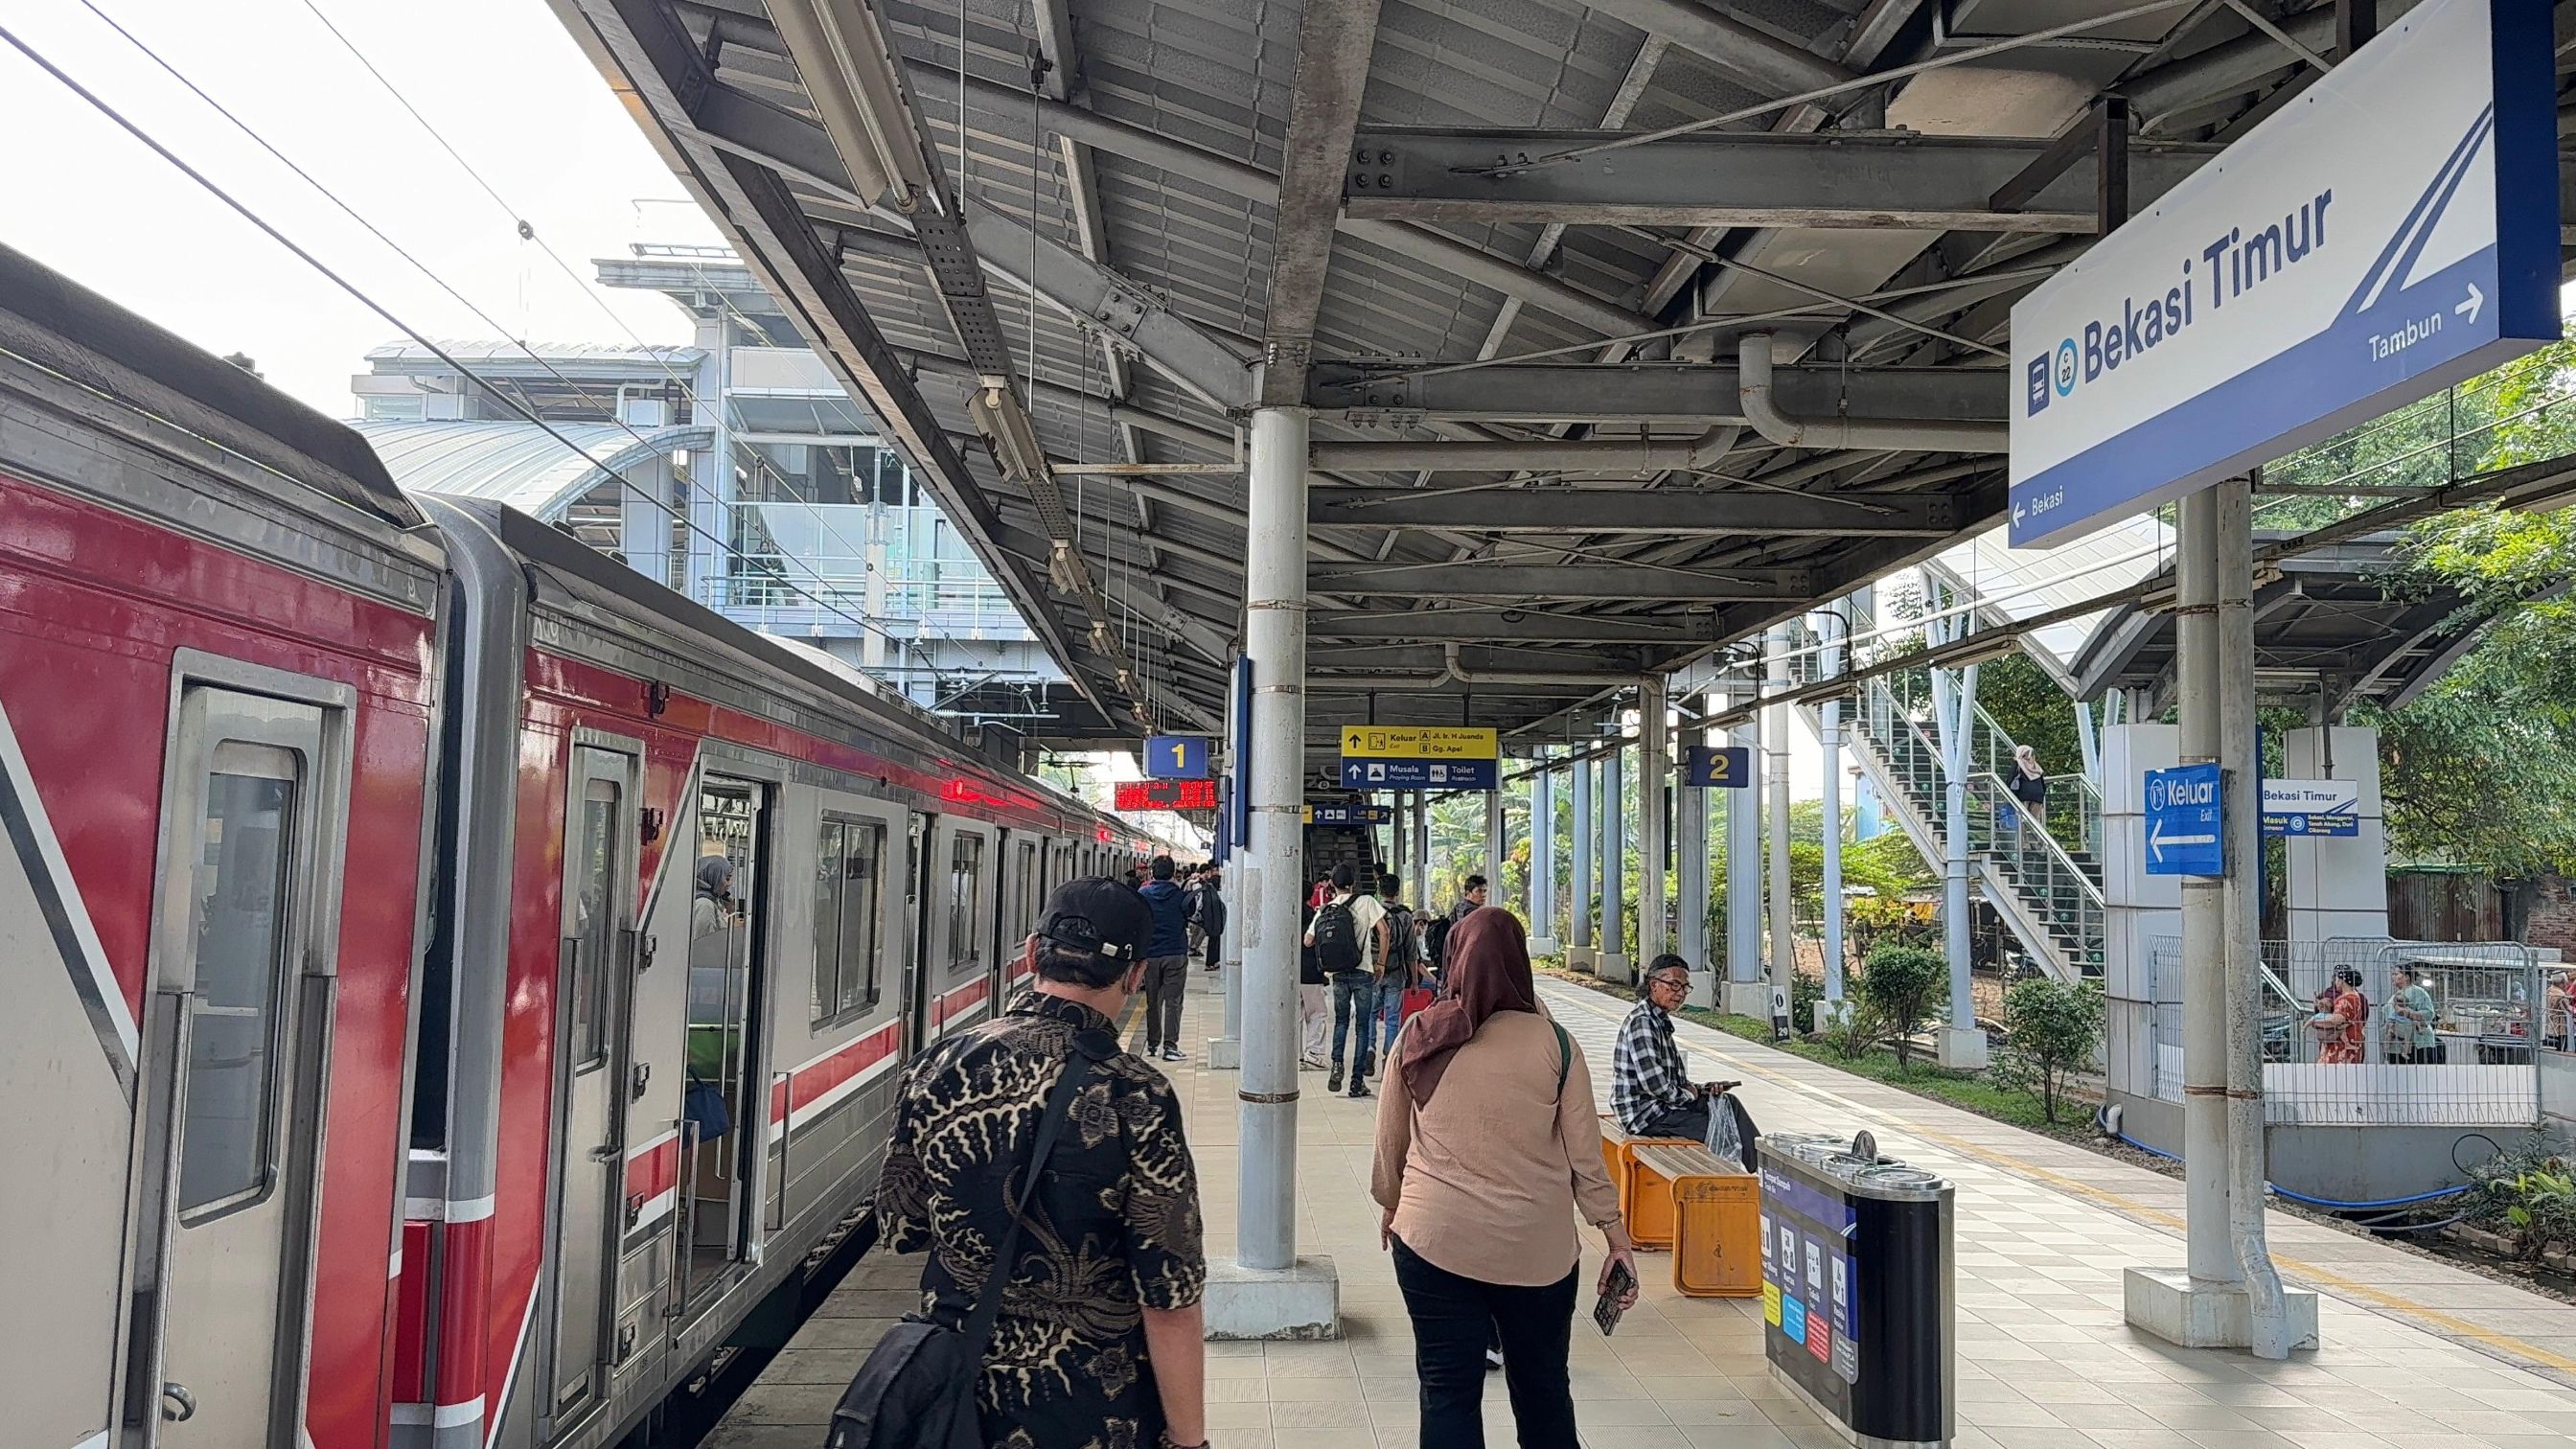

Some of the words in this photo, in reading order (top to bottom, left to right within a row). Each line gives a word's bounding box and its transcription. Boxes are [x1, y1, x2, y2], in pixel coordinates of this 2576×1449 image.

[2084, 259, 2193, 384] Bekasi
[2203, 188, 2332, 310] Timur
[2368, 312, 2442, 363] Tambun
[2063, 352, 2069, 364] C
[2061, 365, 2071, 382] 22
[2032, 485, 2063, 517] Bekasi
[1171, 743, 1184, 769] 1
[1390, 765, 1419, 773] Musala
[1451, 766, 1475, 774] Toilet
[1710, 753, 1730, 780] 2
[2167, 778, 2214, 807] Keluar
[2264, 790, 2300, 801] Bekasi
[2303, 791, 2337, 801] Timur
[2199, 808, 2213, 822] Exit
[1775, 993, 1784, 1008] 0
[1777, 1026, 1789, 1037] 29
